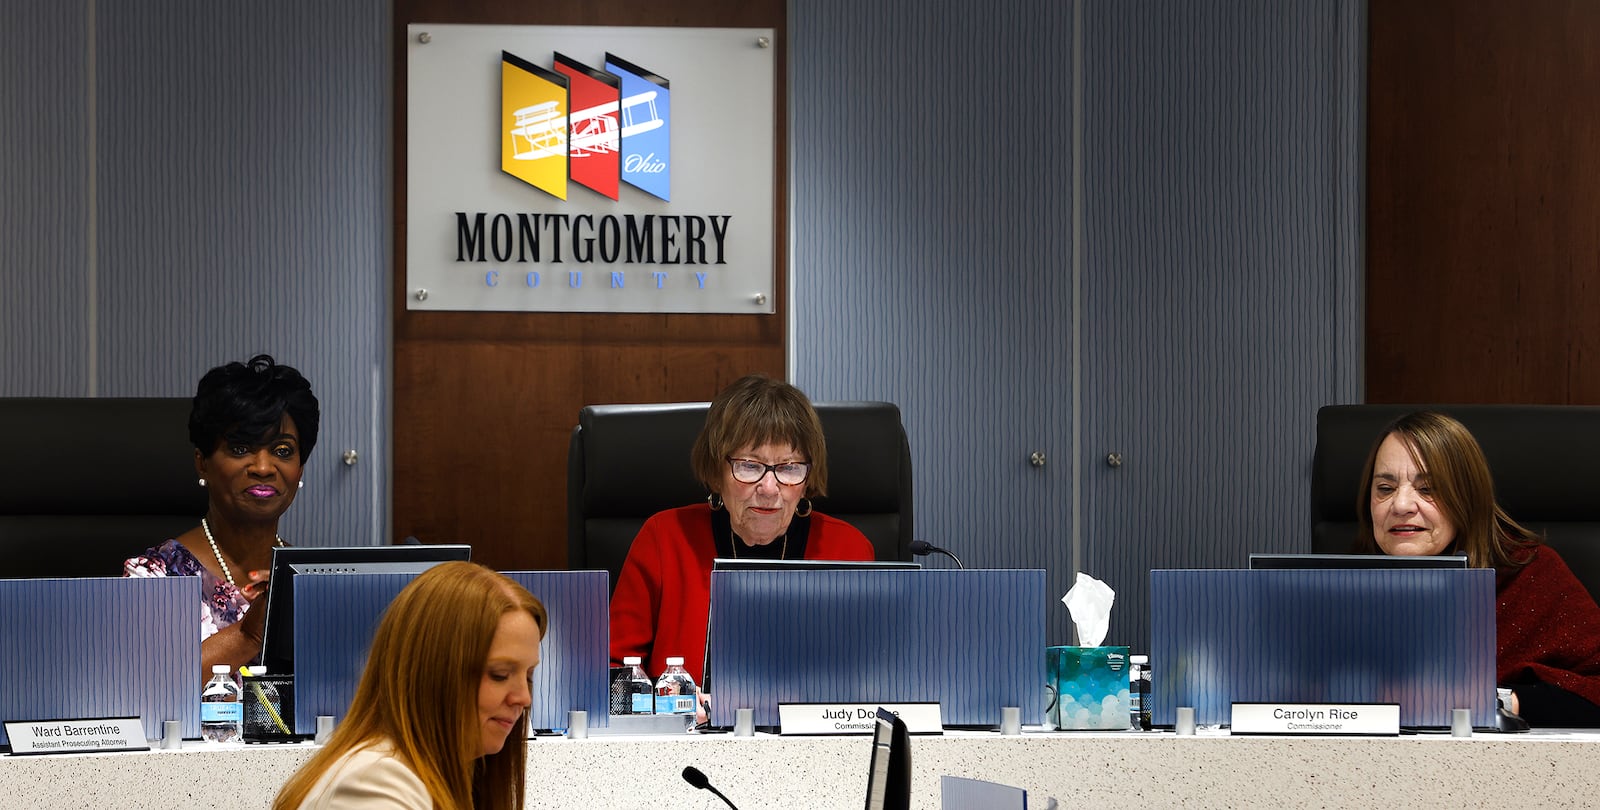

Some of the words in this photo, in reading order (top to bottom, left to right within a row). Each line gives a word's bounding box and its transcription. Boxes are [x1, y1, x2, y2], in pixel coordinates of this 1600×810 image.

[624, 151, 666, 175] Ohio
[455, 212, 732, 266] MONTGOMERY
[485, 270, 710, 290] COUNTY
[822, 708, 853, 722] Judy
[857, 708, 900, 720] Doe
[1273, 708, 1325, 722] Carolyn
[1329, 708, 1358, 720] Rice
[32, 726, 62, 737] Ward
[64, 724, 120, 736] Barrentine
[1287, 722, 1343, 730] Commissioner
[32, 740, 61, 749] Assistant
[62, 739, 100, 748] Prosecuting
[101, 738, 128, 747] Attorney
